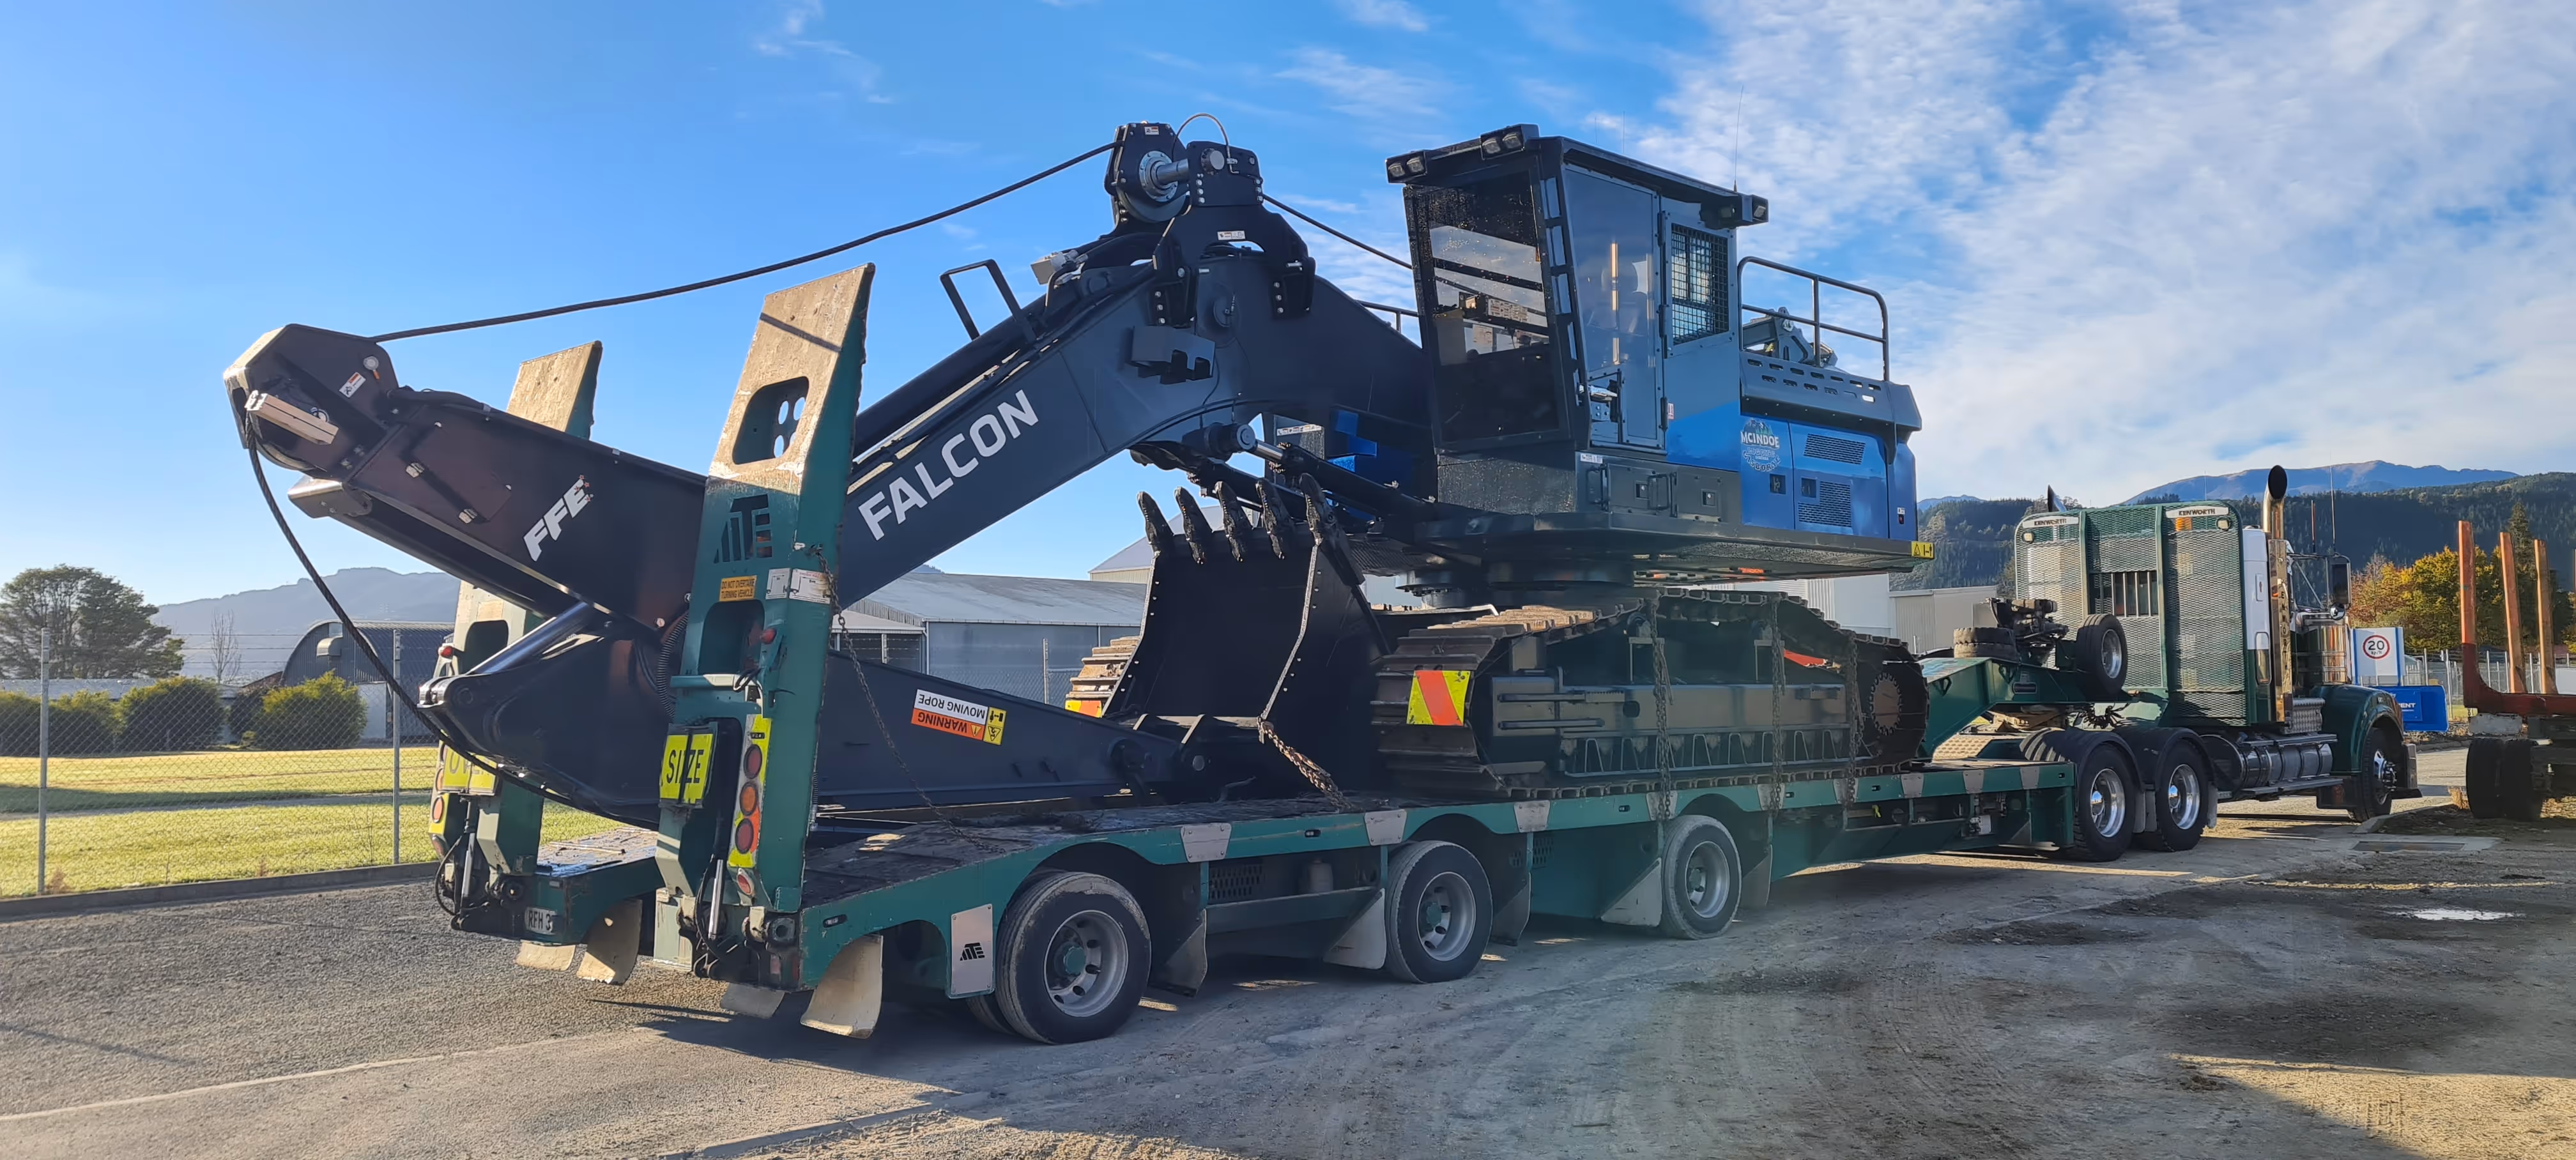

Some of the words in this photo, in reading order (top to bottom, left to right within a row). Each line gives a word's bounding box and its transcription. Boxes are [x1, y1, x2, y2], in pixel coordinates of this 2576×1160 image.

[1740, 431, 1780, 448] MCINDOE
[858, 390, 1039, 541] FALCON
[523, 478, 590, 562] FFE
[2368, 641, 2384, 650] 20
[919, 694, 945, 709] ROPE
[947, 701, 985, 719] MOVING
[917, 712, 967, 733] WARNING
[666, 749, 704, 784] SIZE
